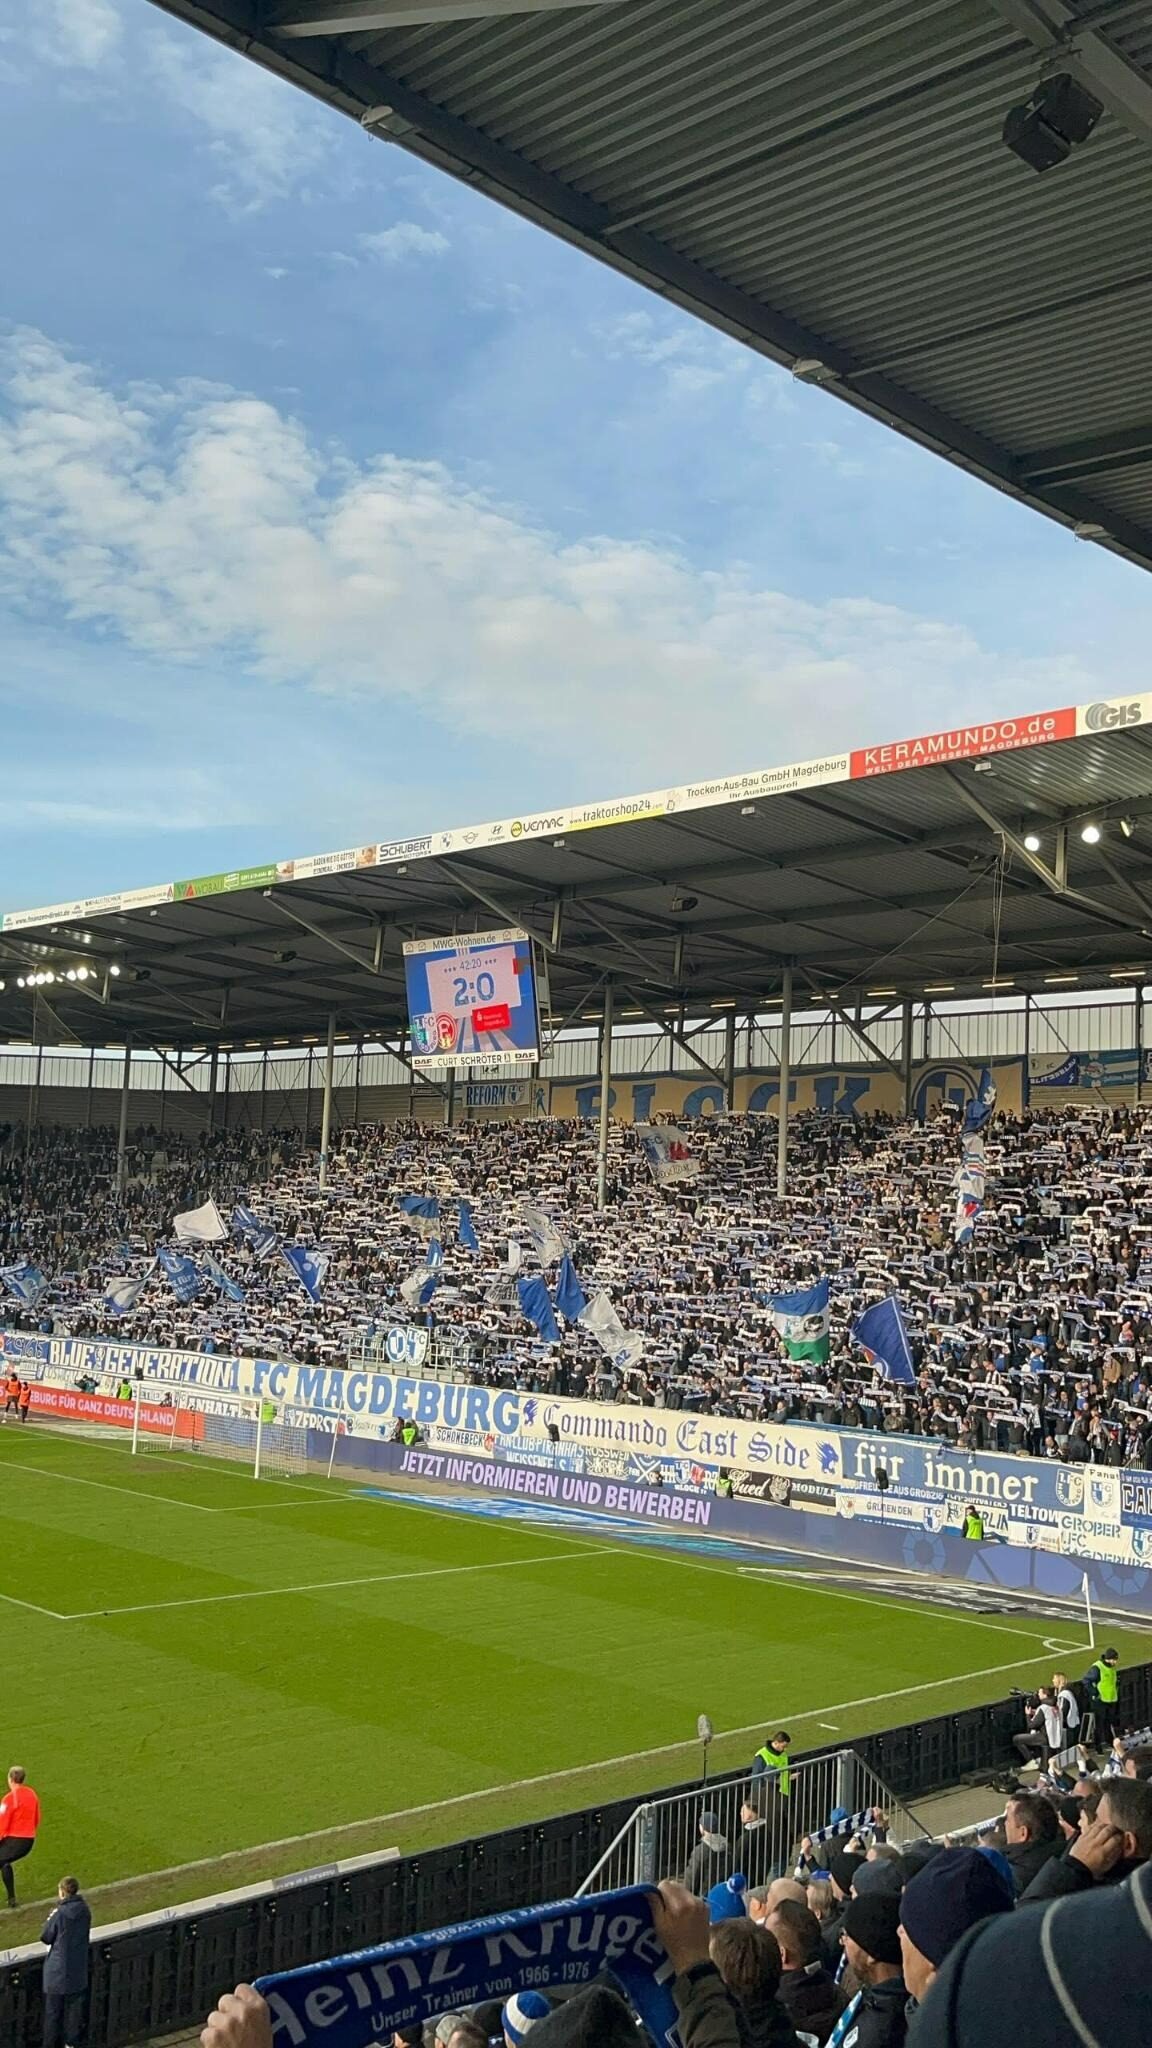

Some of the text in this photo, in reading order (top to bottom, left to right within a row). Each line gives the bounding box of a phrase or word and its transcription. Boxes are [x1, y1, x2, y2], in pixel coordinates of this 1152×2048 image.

[1099, 702, 1142, 730] GIS
[865, 716, 1056, 765] KERAMUNDO.de
[865, 733, 1056, 775] WELT DER FLIESEN MAGDEBURG
[686, 759, 848, 798] Trocken-Aus-Bau GmbH Magdeburg
[744, 781, 798, 797] Ausbauprofi
[380, 841, 432, 857] SCHUBERT
[432, 934, 496, 950] MWG-Wohnen.de
[459, 958, 482, 970] 42:20
[453, 972, 495, 1007] 2:0
[437, 1058, 457, 1067] CURT
[460, 1054, 501, 1066] SCHRÖTER
[466, 1085, 507, 1106] REFORM
[50, 1340, 95, 1370] BLUE
[104, 1348, 232, 1389] GENERATION
[59, 1394, 76, 1410] FÜR
[78, 1401, 102, 1415] GANZ
[104, 1405, 175, 1427] DEUTSHLAND
[295, 1367, 520, 1435] MAGDEBURG
[543, 1403, 810, 1470] Commando East Side
[400, 1450, 445, 1477] JETZT
[445, 1458, 560, 1499] INFORMIEREN
[562, 1477, 602, 1506] UND
[605, 1484, 711, 1526] BEWERBEN
[854, 1441, 1039, 1502] für immer
[371, 2005, 417, 2033] Unser
[422, 1983, 479, 2013] Trainer
[485, 1975, 512, 1994] von
[519, 1963, 549, 1986] 1966
[563, 1961, 590, 1980] 1976
